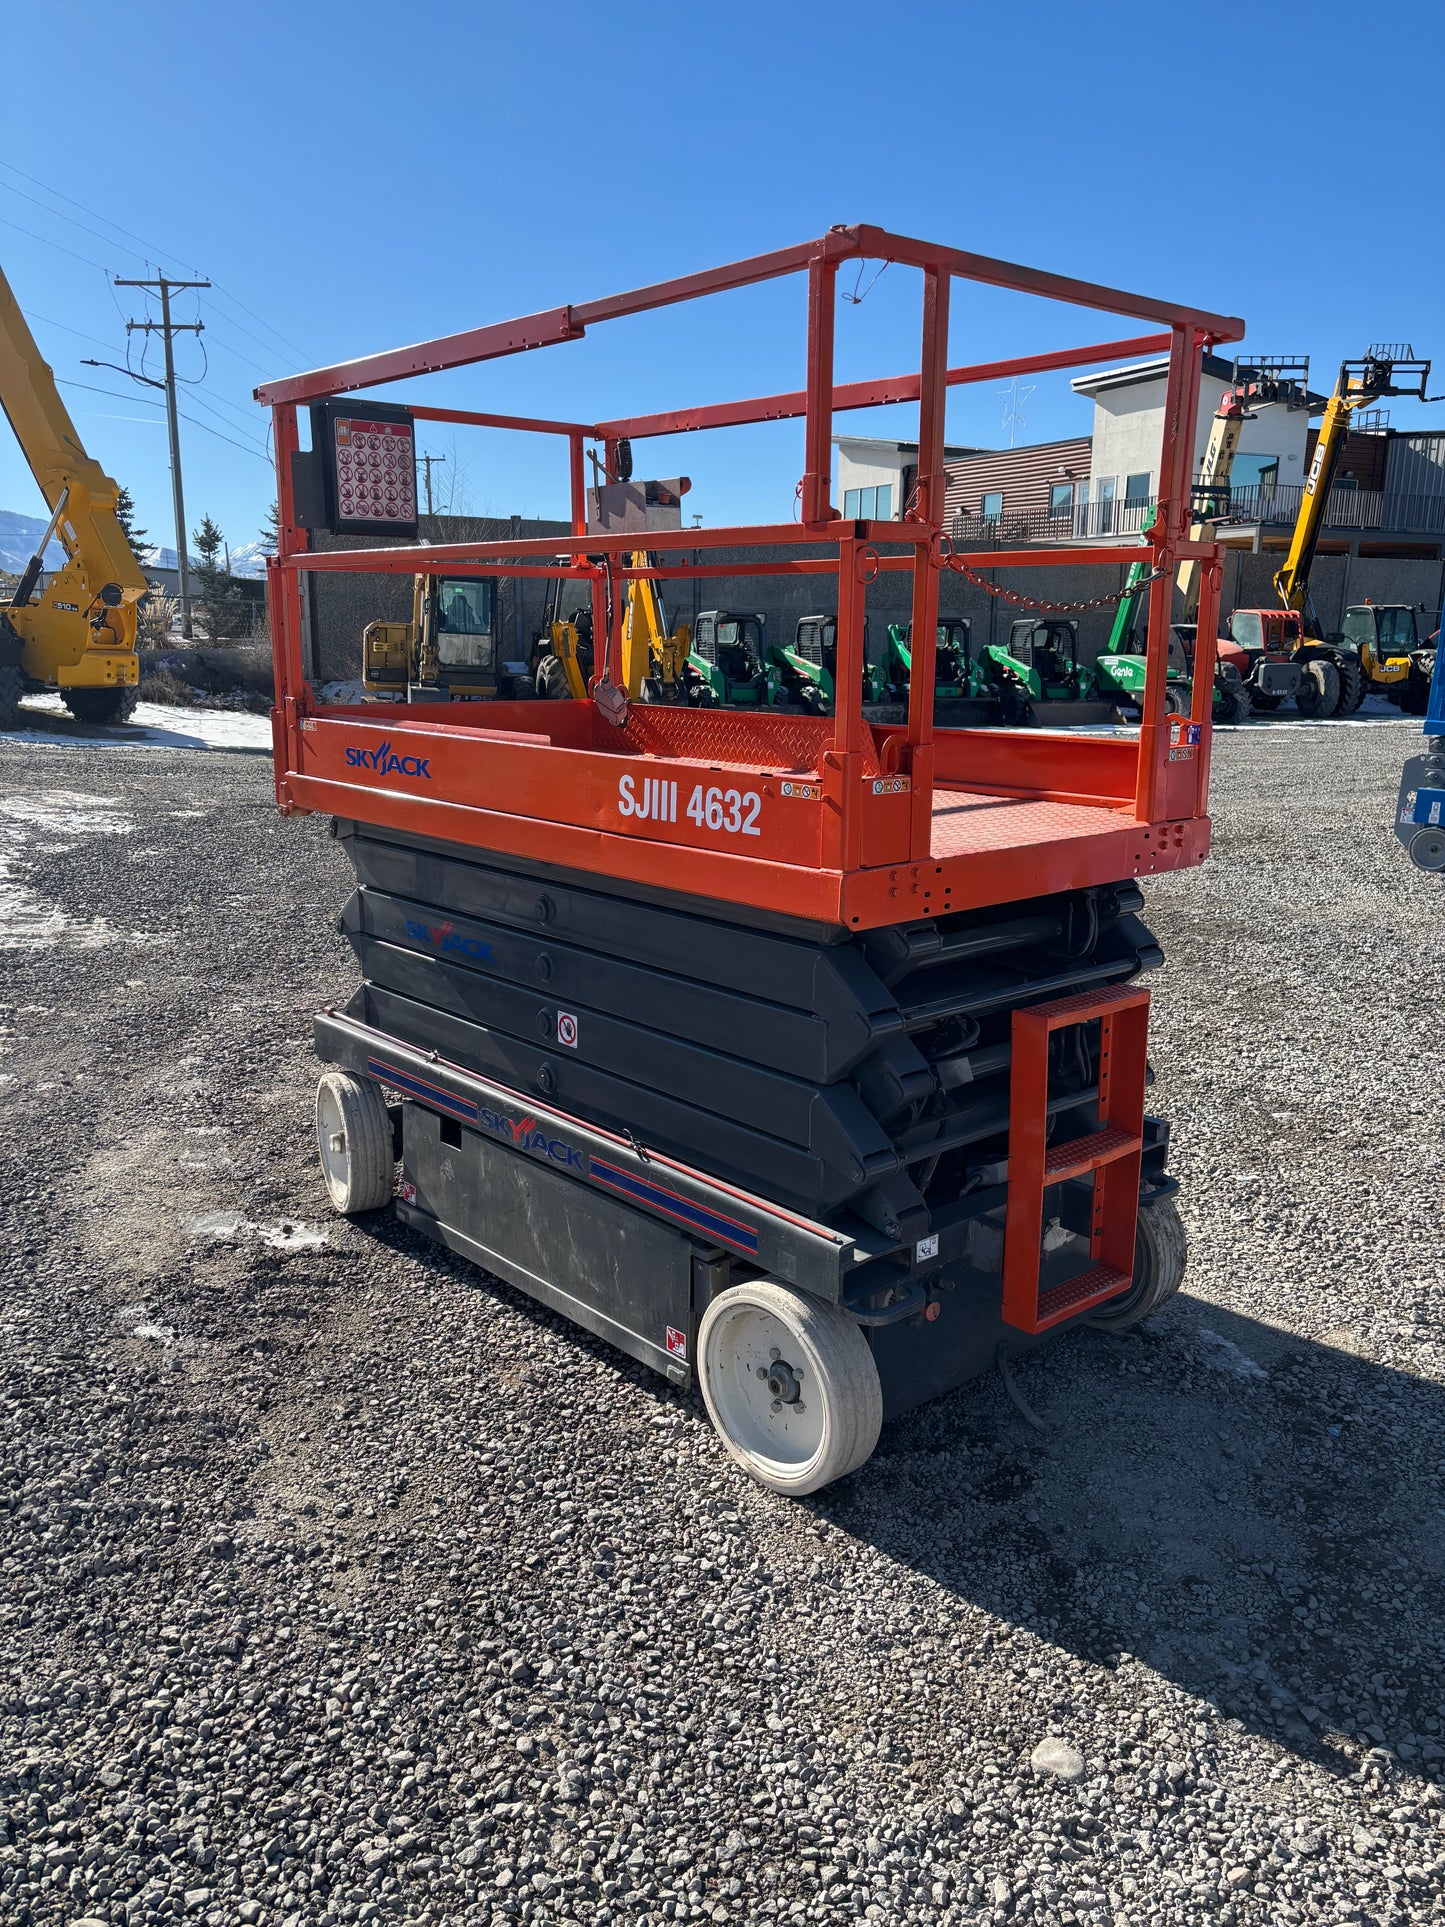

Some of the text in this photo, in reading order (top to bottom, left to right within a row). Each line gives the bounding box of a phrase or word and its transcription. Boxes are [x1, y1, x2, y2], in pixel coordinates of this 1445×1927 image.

[1306, 442, 1326, 496] JCB
[1110, 664, 1134, 677] Genie
[345, 740, 432, 779] SKYJACK
[618, 774, 762, 836] SJIII 4632
[405, 920, 496, 965] SKYJACK
[480, 1107, 586, 1172] SKYJACK
